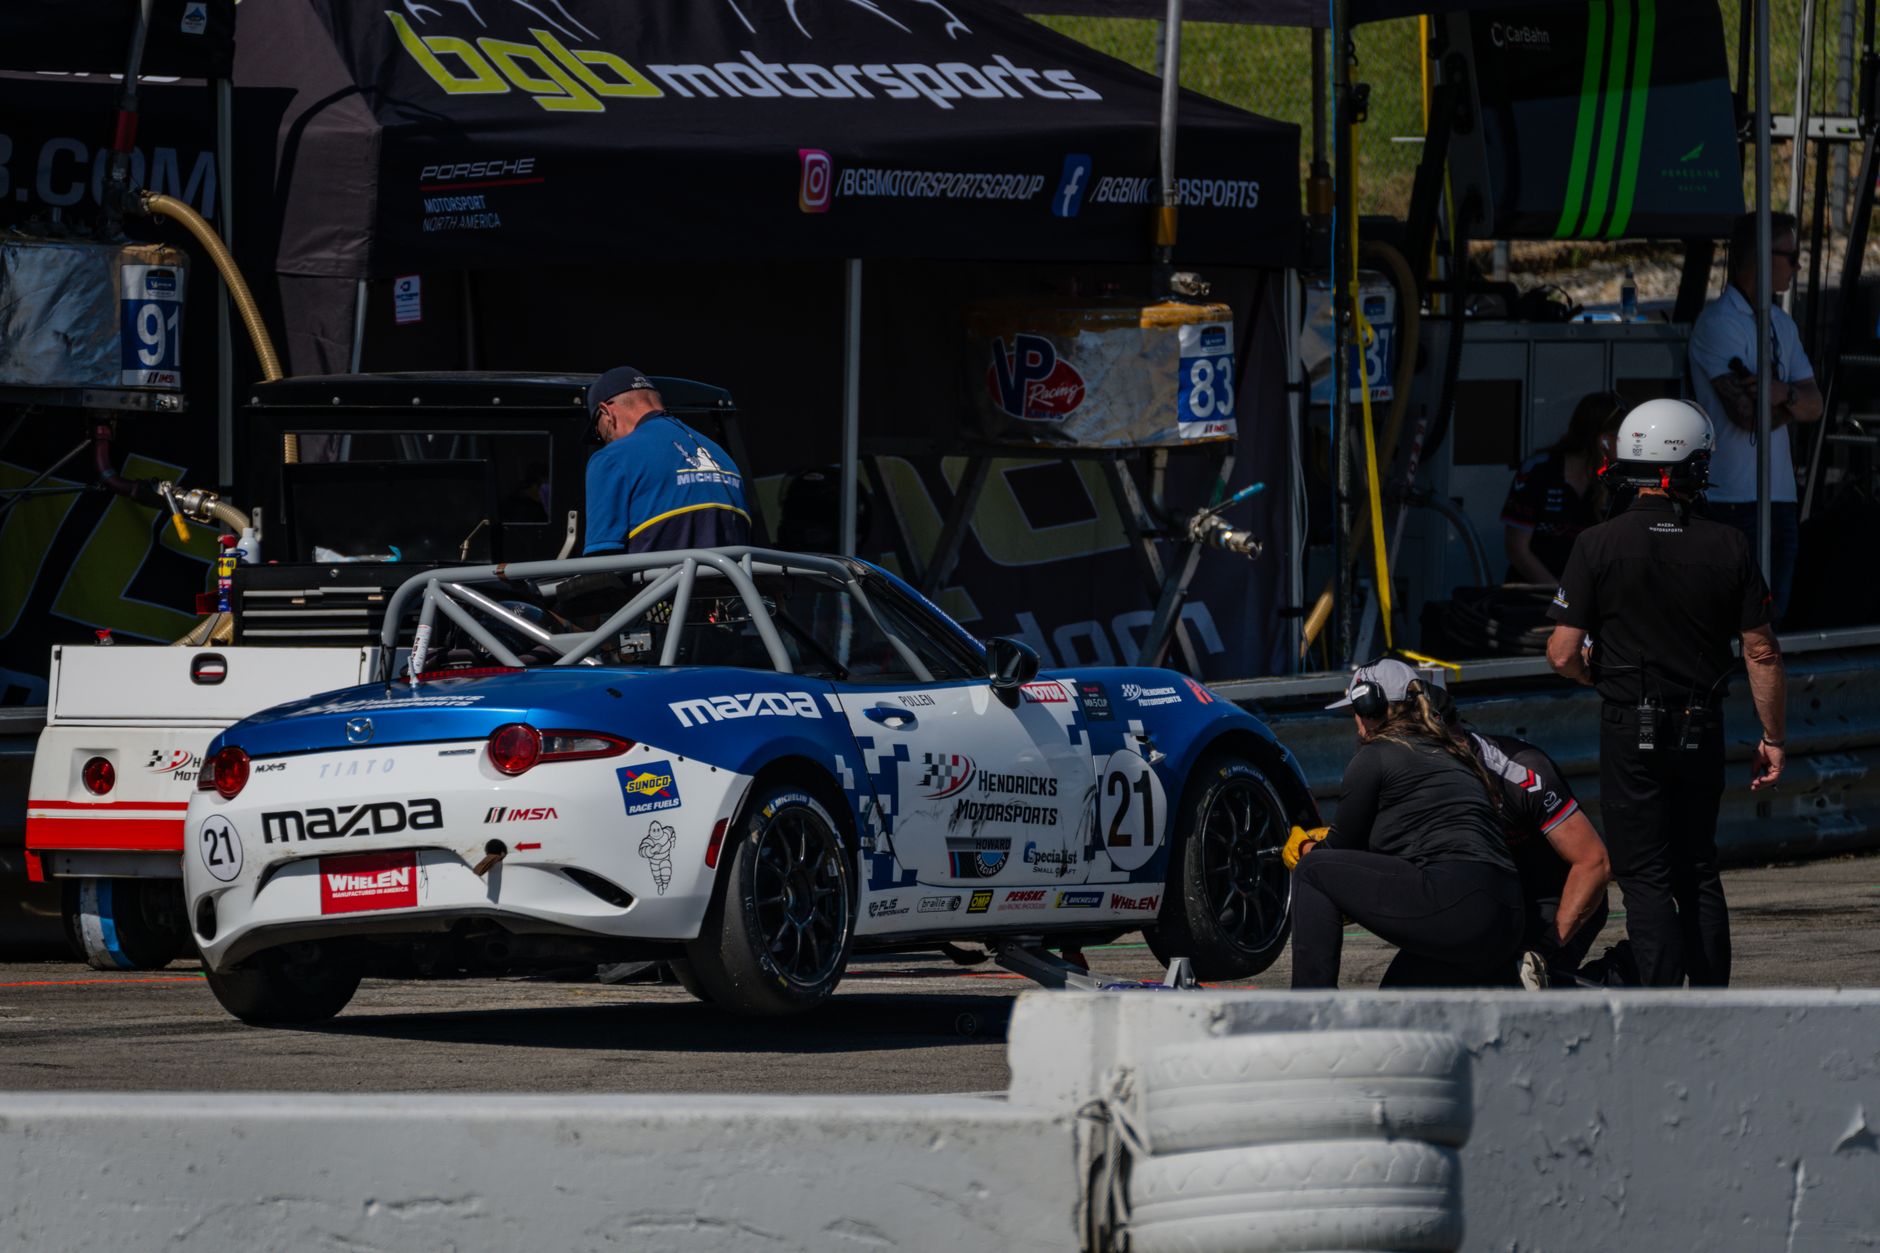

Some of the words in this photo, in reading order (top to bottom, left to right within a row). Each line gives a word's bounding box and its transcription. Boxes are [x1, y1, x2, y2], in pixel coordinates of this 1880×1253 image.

[1506, 25, 1551, 43] CarBahn
[384, 10, 665, 112] bgb
[646, 50, 1103, 110] motorsports
[419, 157, 536, 181] PORSCHE
[834, 168, 1046, 200] /BGBMOTORSPORTSGROUP
[424, 195, 487, 214] MOTORSPORT
[422, 215, 456, 232] NORTH
[457, 212, 501, 230] AMERICA
[136, 303, 180, 367] 91
[1028, 381, 1084, 408] Racing
[1189, 357, 1235, 418] 83
[676, 471, 740, 488] MICHELIN
[899, 694, 935, 707] PULLEN
[1024, 685, 1063, 700] MOTUL
[629, 776, 669, 792] SUNOCO
[979, 770, 1057, 796] HENDRICKS
[507, 807, 558, 821] IMSA
[629, 803, 652, 814] RACE
[653, 798, 680, 810] FUELS
[957, 798, 1057, 826] MOTORSPORTS
[1107, 770, 1154, 847] 21
[204, 826, 235, 866] 21
[976, 839, 1011, 850] HOWARD
[327, 867, 409, 892] WHELEN
[970, 897, 990, 907] OMP
[1005, 890, 1047, 902] PENSKE
[1111, 894, 1159, 910] WHELEN
